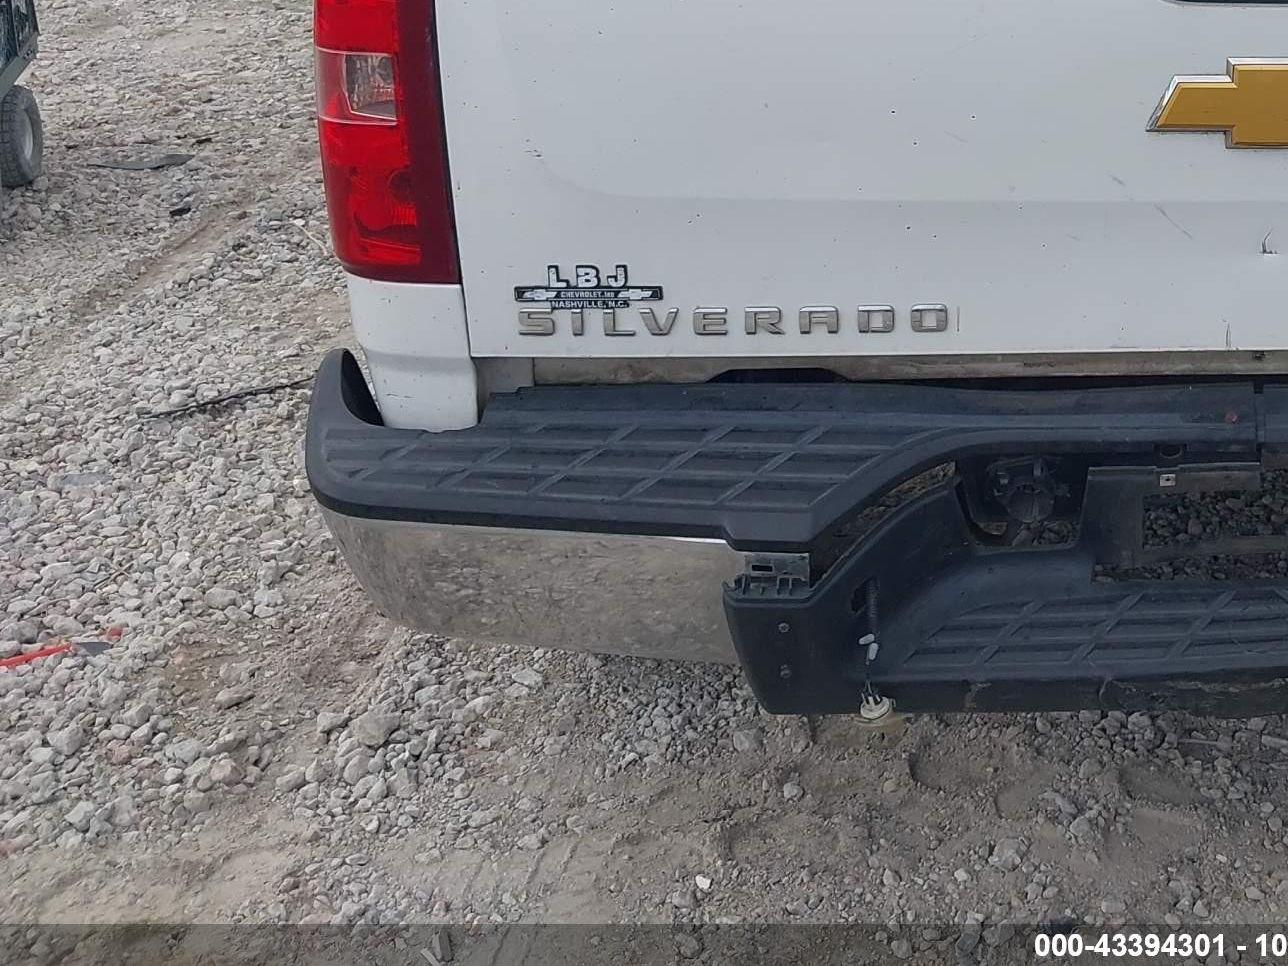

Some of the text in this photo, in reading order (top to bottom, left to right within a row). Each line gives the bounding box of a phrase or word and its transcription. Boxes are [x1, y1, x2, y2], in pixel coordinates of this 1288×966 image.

[551, 300, 628, 309] NASHVILLE, N.C.
[518, 304, 949, 336] SILVERADO
